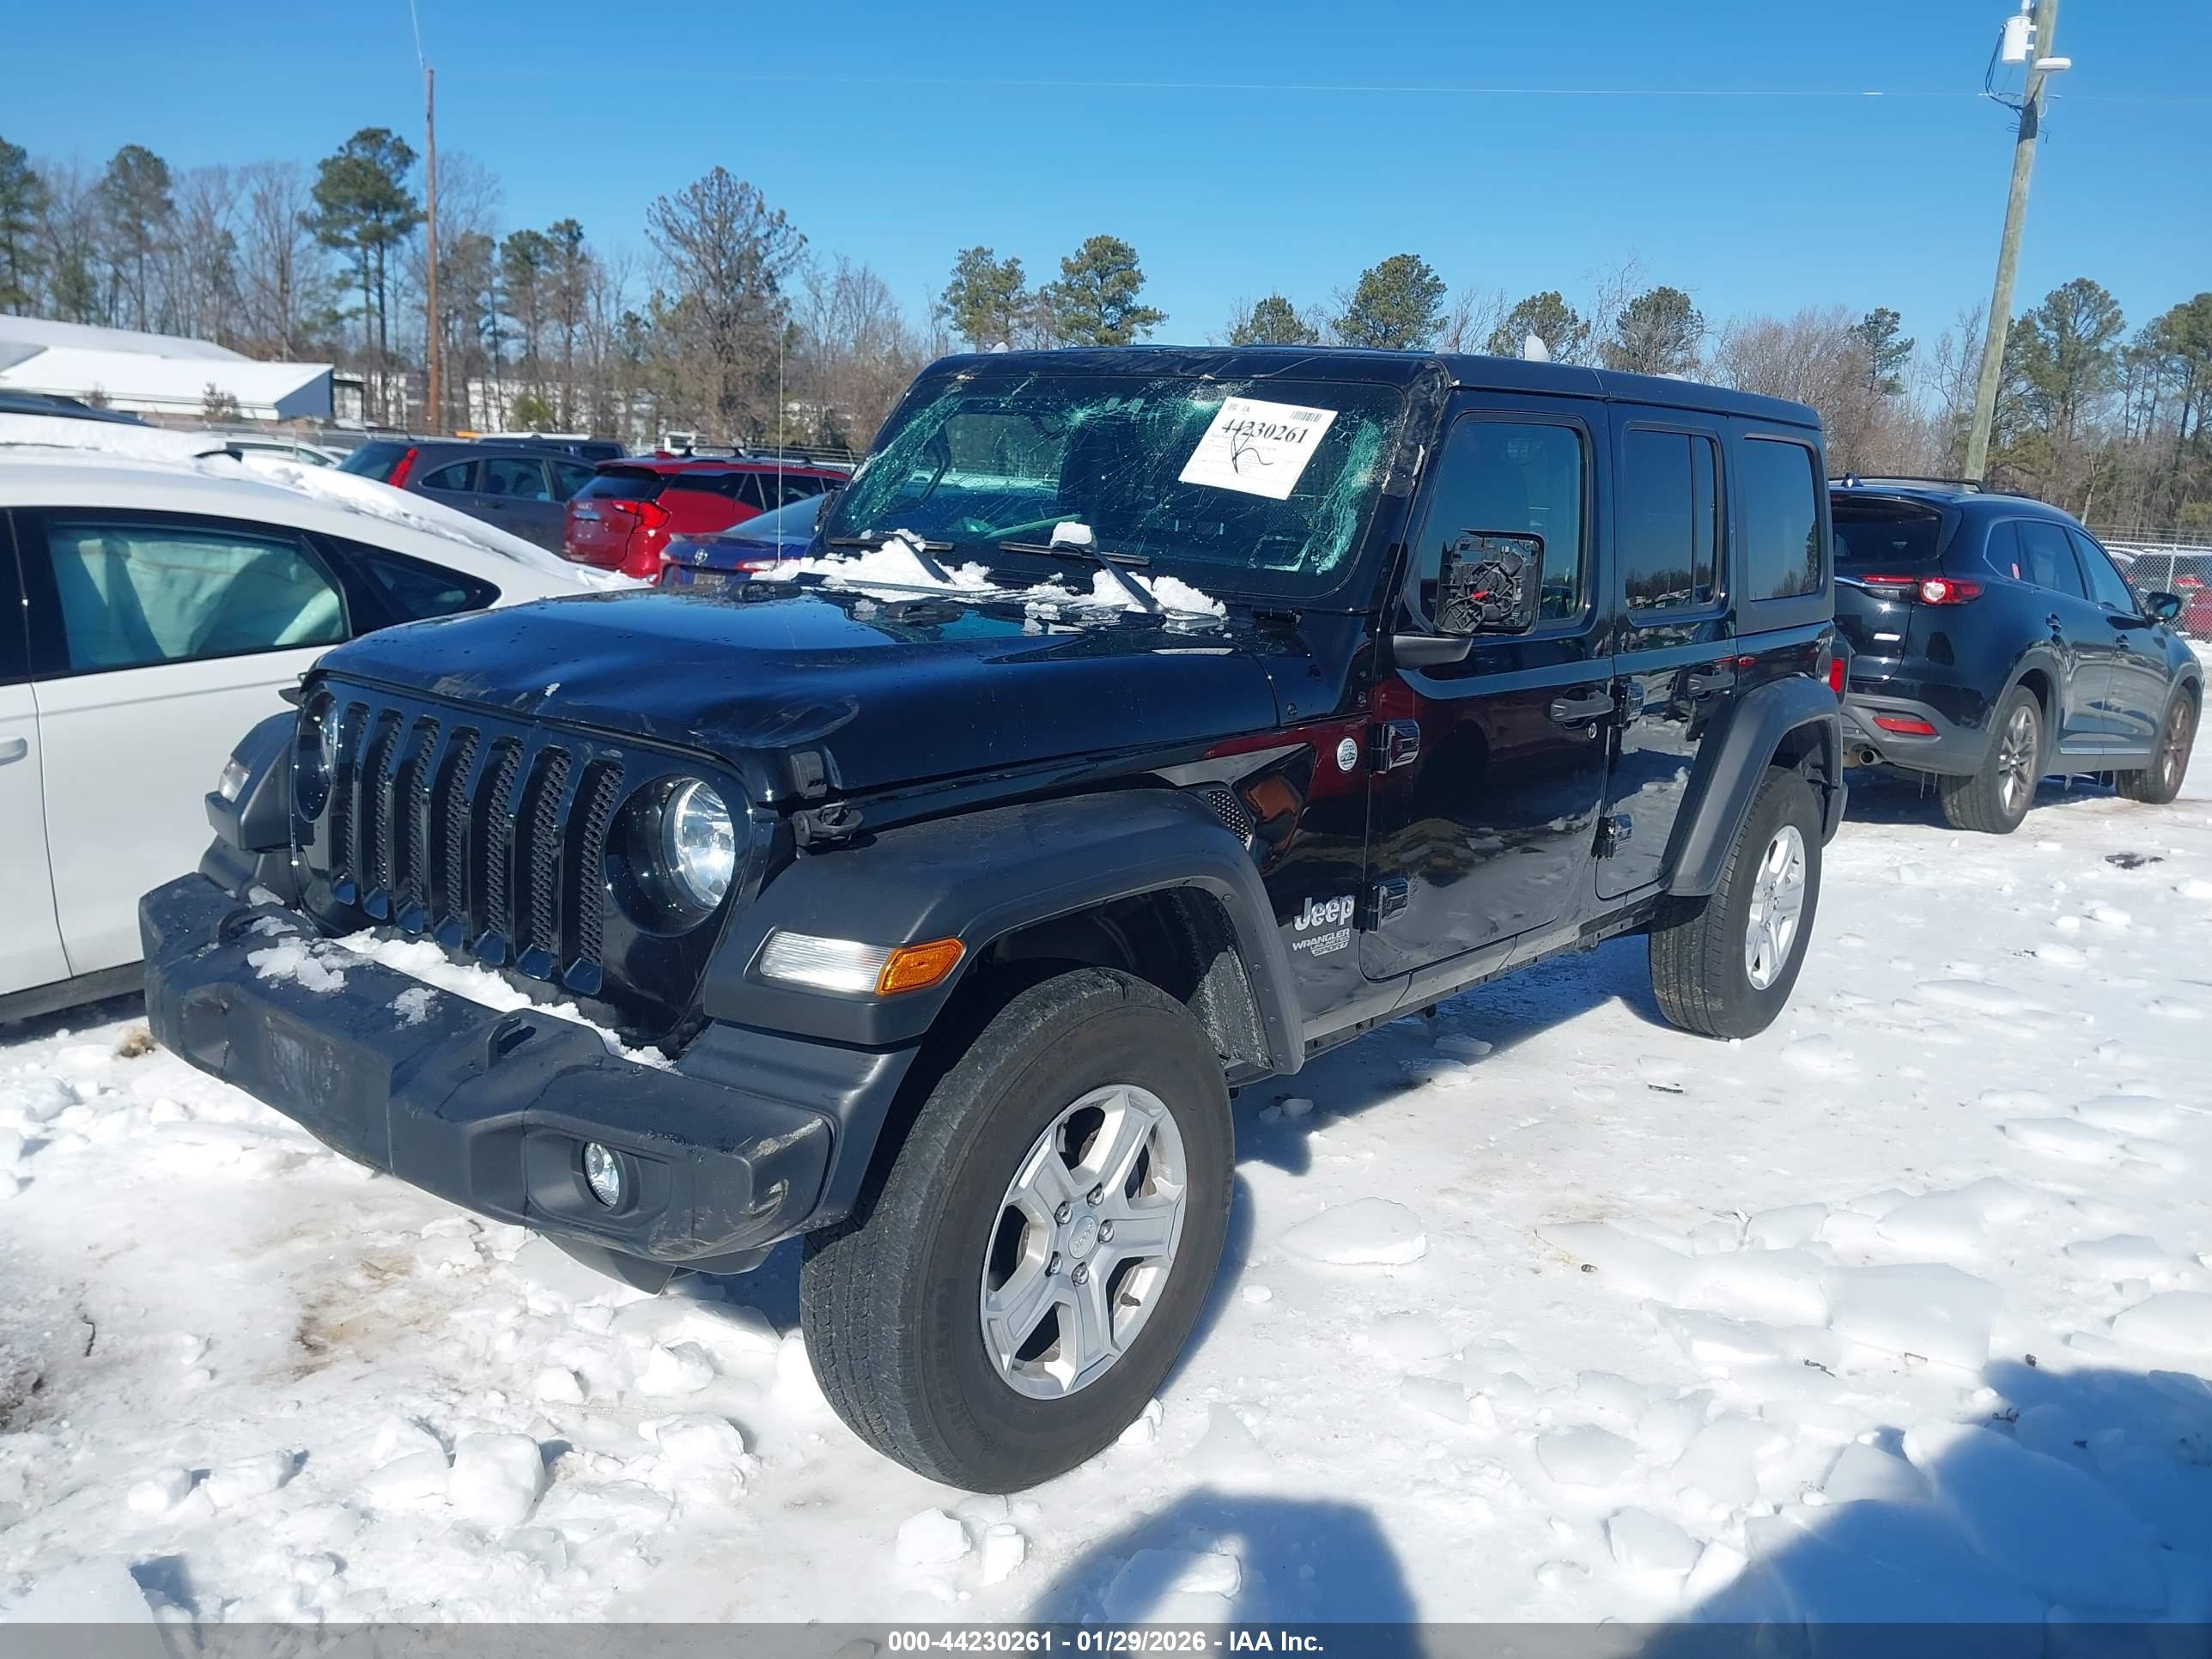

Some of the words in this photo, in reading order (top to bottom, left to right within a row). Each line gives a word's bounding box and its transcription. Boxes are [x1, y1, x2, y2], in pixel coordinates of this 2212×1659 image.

[1222, 418, 1310, 444] 44230261
[1293, 895, 1355, 931] Jeep
[1291, 928, 1350, 951] WRANGLER
[1310, 936, 1350, 950] UNLIMITED
